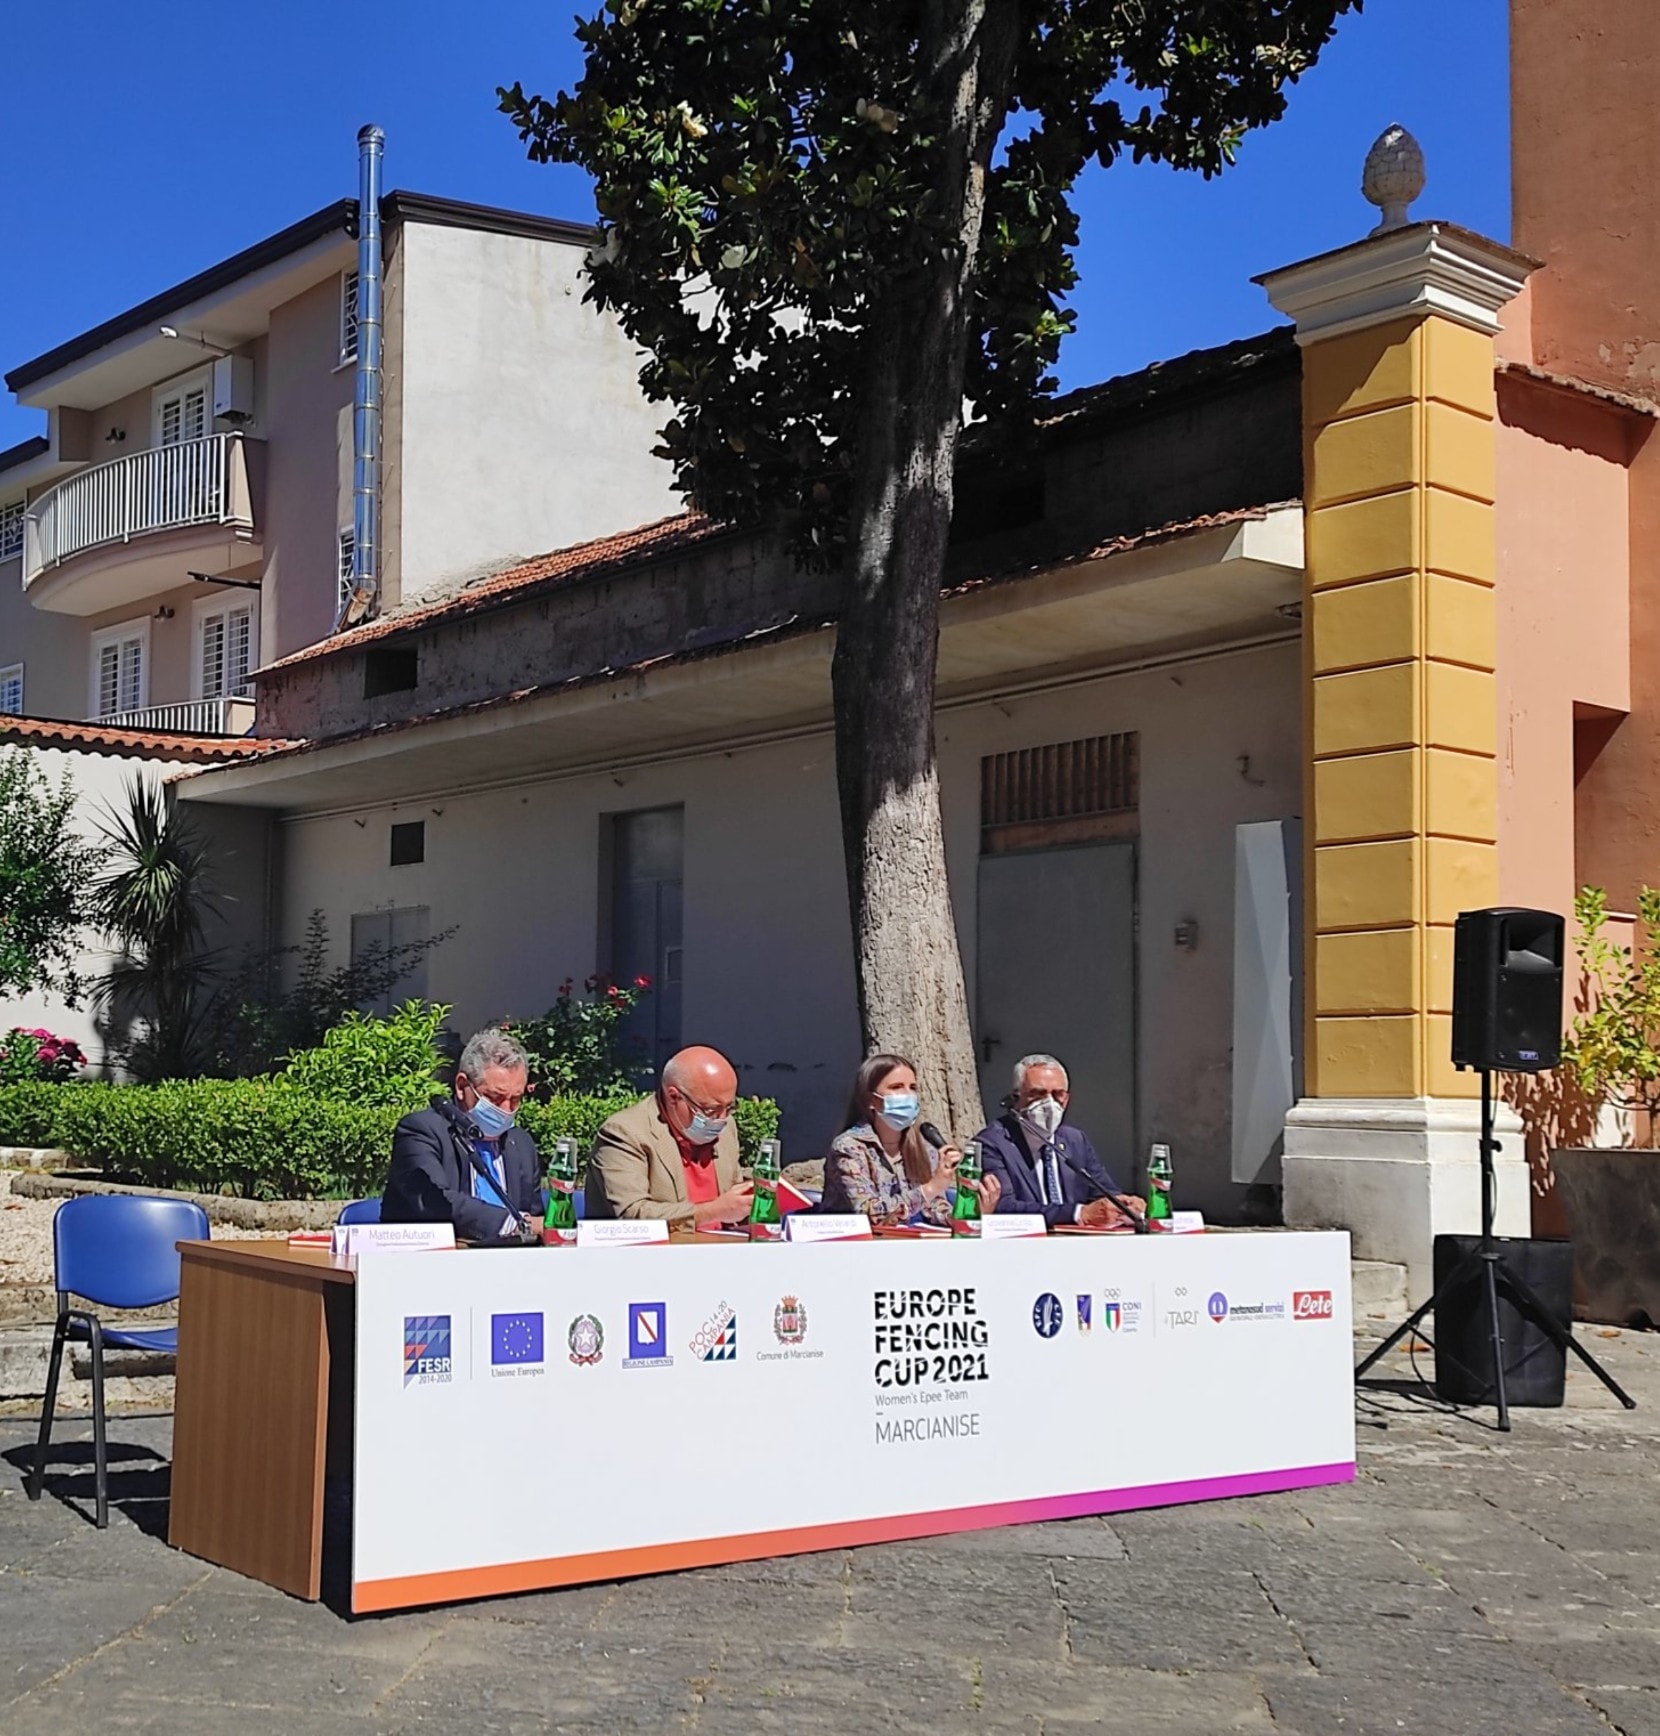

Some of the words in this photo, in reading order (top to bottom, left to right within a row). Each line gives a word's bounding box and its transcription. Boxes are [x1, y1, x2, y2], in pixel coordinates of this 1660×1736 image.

[369, 1229, 400, 1241] Matteo
[874, 1288, 976, 1320] EUROPE
[1122, 1302, 1141, 1311] CONI
[1294, 1293, 1332, 1317] Lete
[689, 1322, 713, 1354] POC
[697, 1308, 736, 1360] CAMPANIA
[875, 1320, 988, 1354] FENCING
[418, 1359, 450, 1373] FESR
[756, 1352, 783, 1361] Comune
[784, 1351, 790, 1360] di
[790, 1350, 824, 1360] Marcianise
[418, 1374, 452, 1385] 2014-2020
[491, 1367, 516, 1378] Unione
[517, 1366, 544, 1378] Europea
[874, 1357, 929, 1388] CUP
[933, 1353, 989, 1384] 2021
[875, 1393, 918, 1407] Women's
[920, 1391, 942, 1405] Epee
[944, 1389, 968, 1401] Team
[876, 1413, 980, 1444] MARCIANISE
